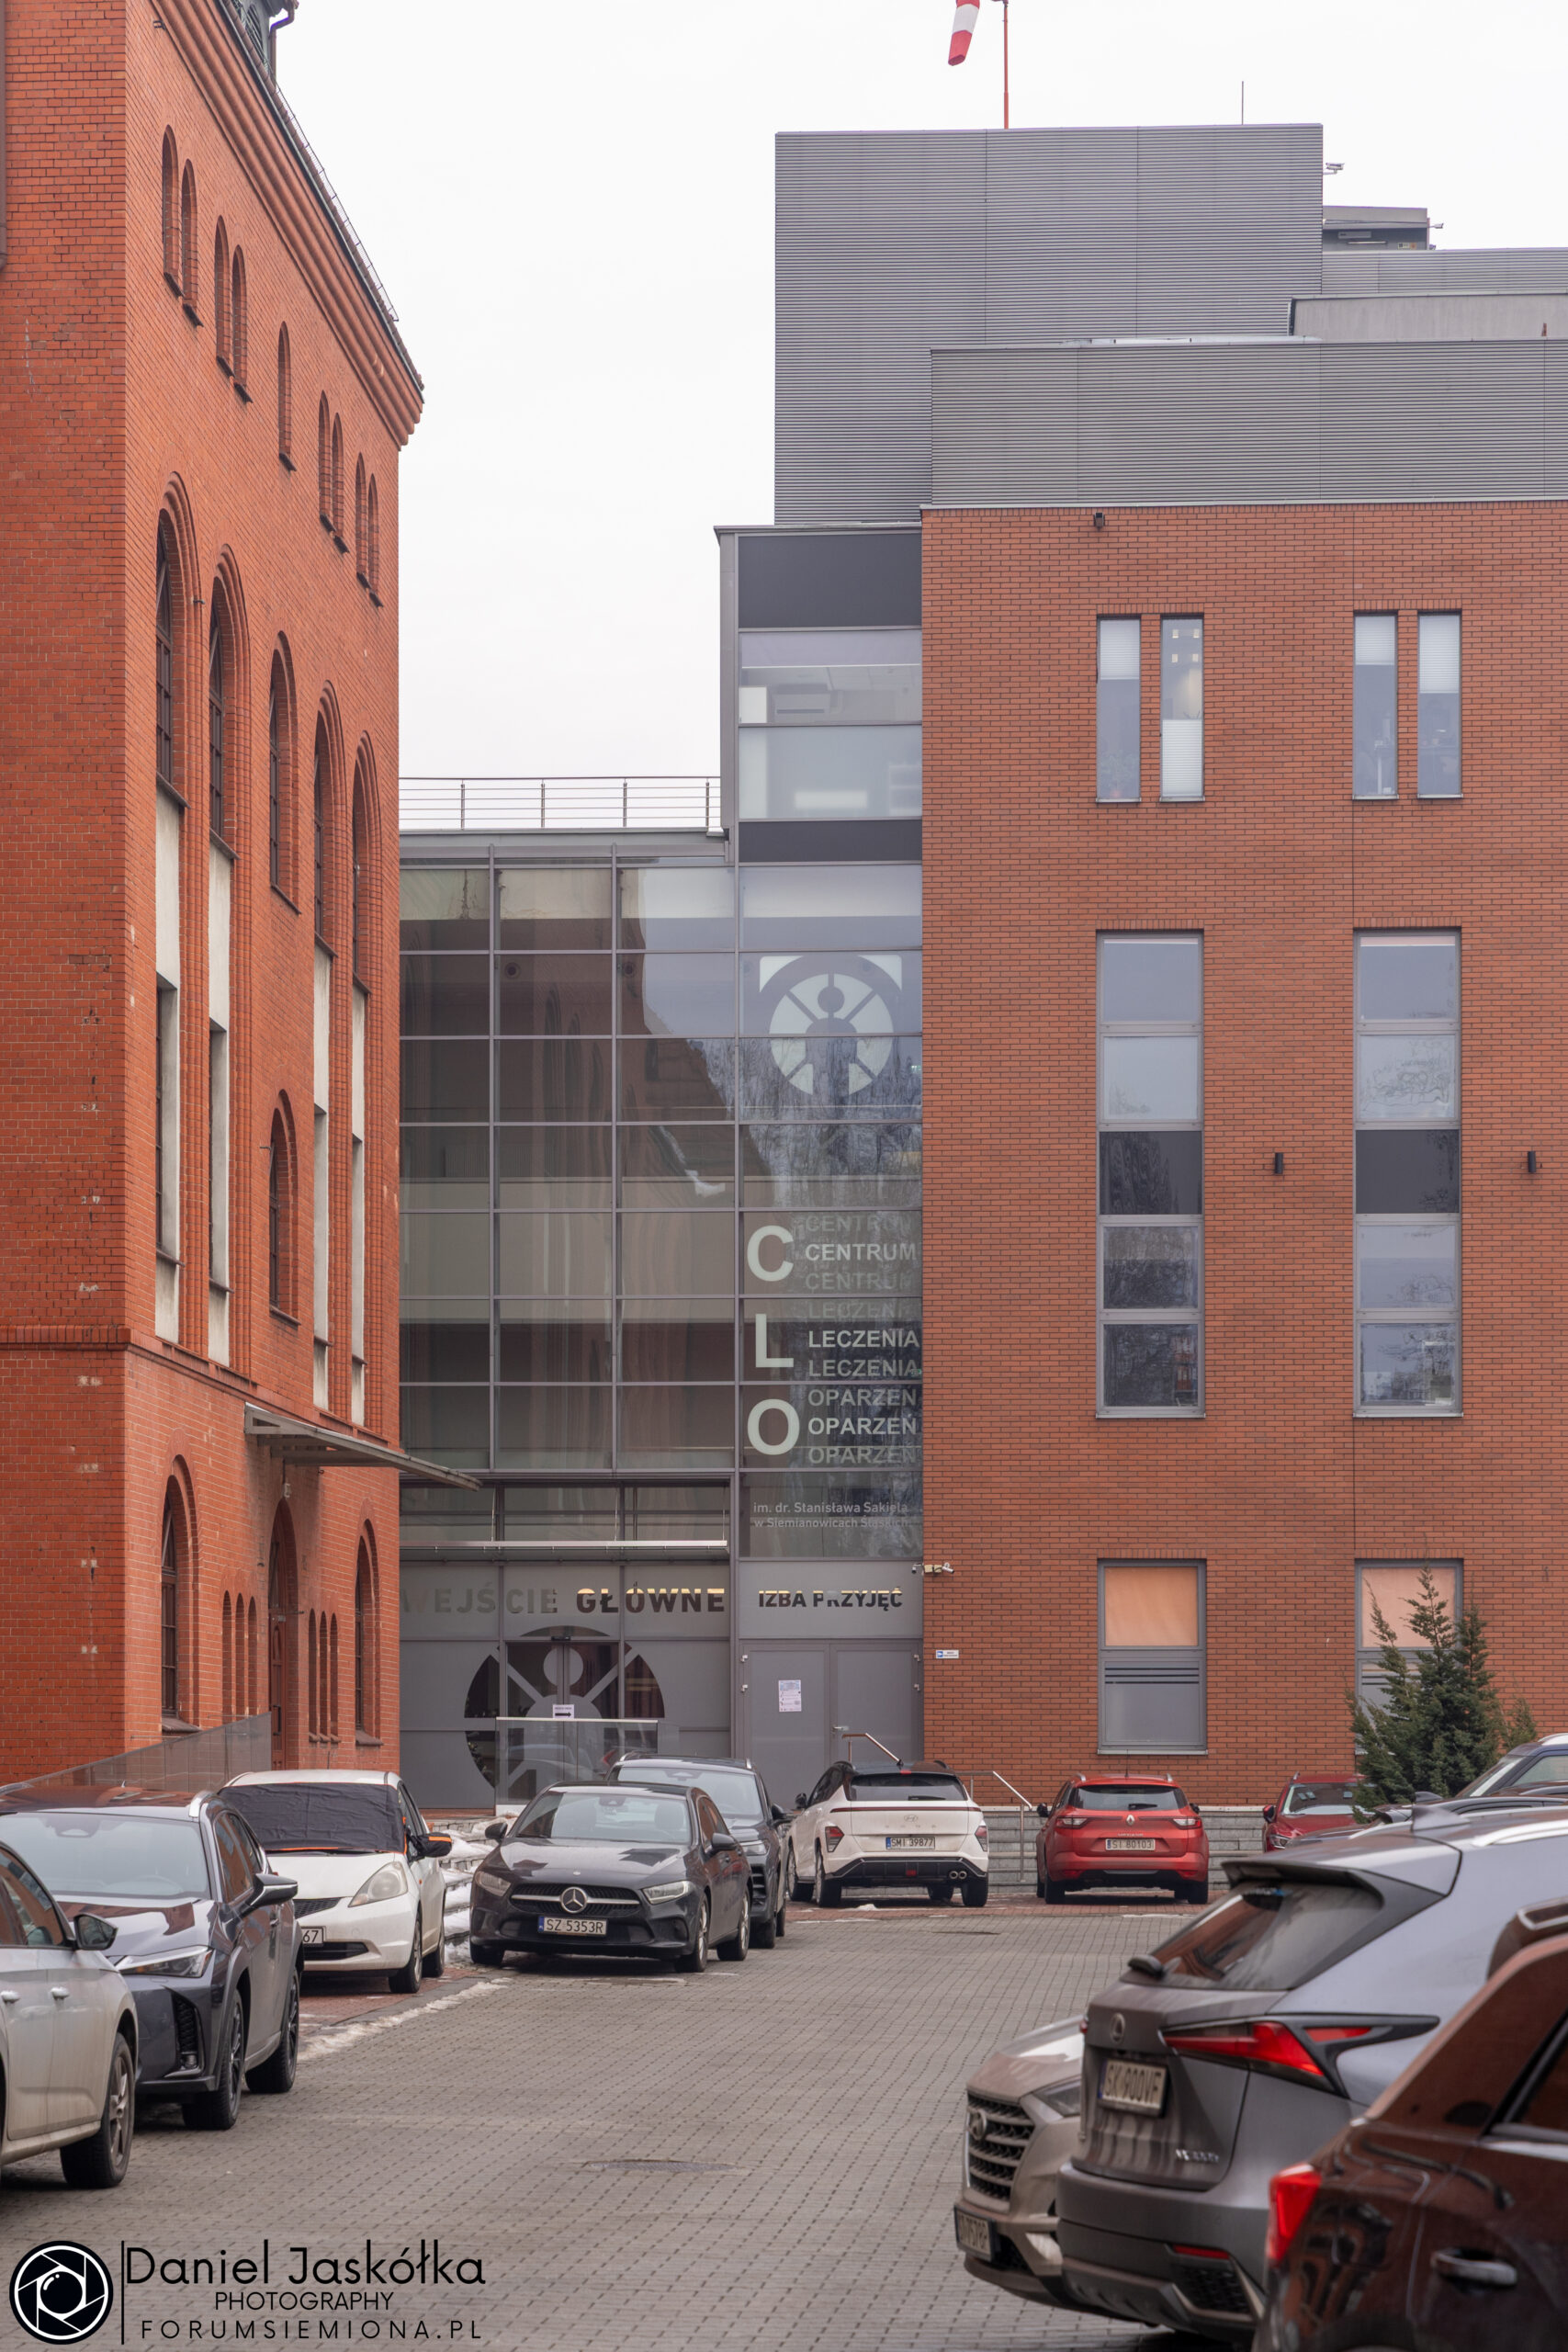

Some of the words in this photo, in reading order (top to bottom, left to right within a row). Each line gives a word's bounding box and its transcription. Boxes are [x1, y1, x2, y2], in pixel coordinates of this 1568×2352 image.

[747, 1225, 794, 1283] C
[806, 1243, 917, 1261] CENTRUM
[755, 1313, 794, 1368] L
[808, 1330, 920, 1348] LECZENIA
[808, 1360, 919, 1377] LECZENIA
[747, 1398, 800, 1456] O
[753, 1502, 772, 1513] im.
[775, 1502, 791, 1513] dr.
[794, 1502, 861, 1513] Stanisława
[754, 1519, 764, 1528] w
[767, 1518, 859, 1528] Siemianowicach
[576, 1581, 725, 1613] GŁÓWNE
[759, 1590, 807, 1608] IZBA
[891, 1838, 906, 1848] SMI
[908, 1838, 933, 1848] 39877
[547, 1919, 561, 1931] SZ
[566, 1920, 604, 1933] 5353R
